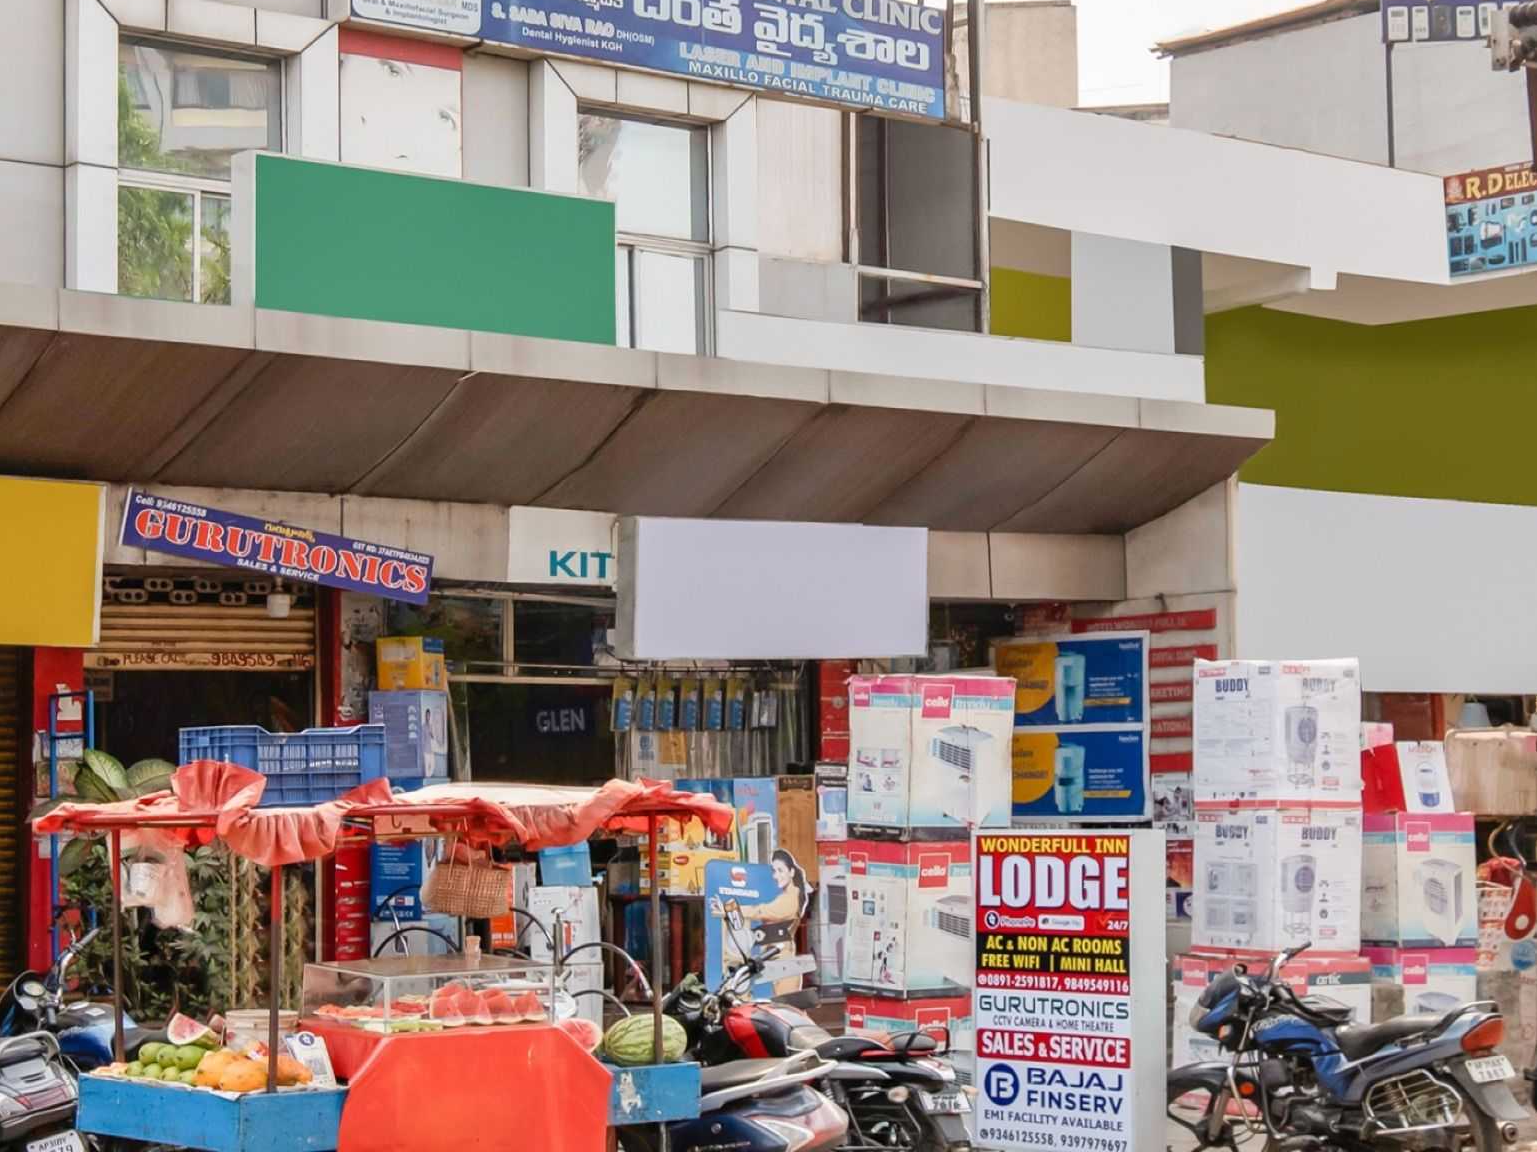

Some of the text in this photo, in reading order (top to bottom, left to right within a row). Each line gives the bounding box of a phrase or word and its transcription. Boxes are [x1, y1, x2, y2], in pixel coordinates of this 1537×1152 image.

[460, 0, 480, 13] MDS
[521, 26, 624, 53] Dental Hygienist KGH
[688, 60, 928, 114] MAXILLO FACIAL TRAUMA CARE
[745, 54, 786, 75] AND
[876, 78, 936, 104] CLINIC
[134, 507, 429, 594] GURUTRONICS
[237, 557, 268, 572] SALES
[280, 566, 321, 583] SERVICE
[549, 549, 613, 579] KIT
[1215, 677, 1249, 693] BUDDY
[536, 708, 586, 733] GLEN
[980, 837, 1128, 854] WONDERFULL INN
[979, 854, 1130, 911] LODGE
[1106, 920, 1129, 931] 24/7
[986, 935, 1122, 955] AC & NON AC ROOMS
[981, 953, 1127, 973] FREE WIFI MINI HALL
[1064, 977, 1129, 993] 9849549116
[979, 994, 1129, 1020] GURUTRONICS
[993, 1015, 1013, 1027] CCTV
[1013, 1016, 1046, 1029] CAMERA
[1056, 1019, 1079, 1031] HOME
[1081, 1021, 1115, 1033] THEATRE
[981, 1030, 1127, 1064] SALES & SERVICE
[1026, 1066, 1124, 1093] BAJAJ
[1026, 1089, 1124, 1115] FINSERV
[984, 1109, 1124, 1132] EMI FACILITY AVAILABLE
[1060, 1133, 1128, 1152] 9397979697
